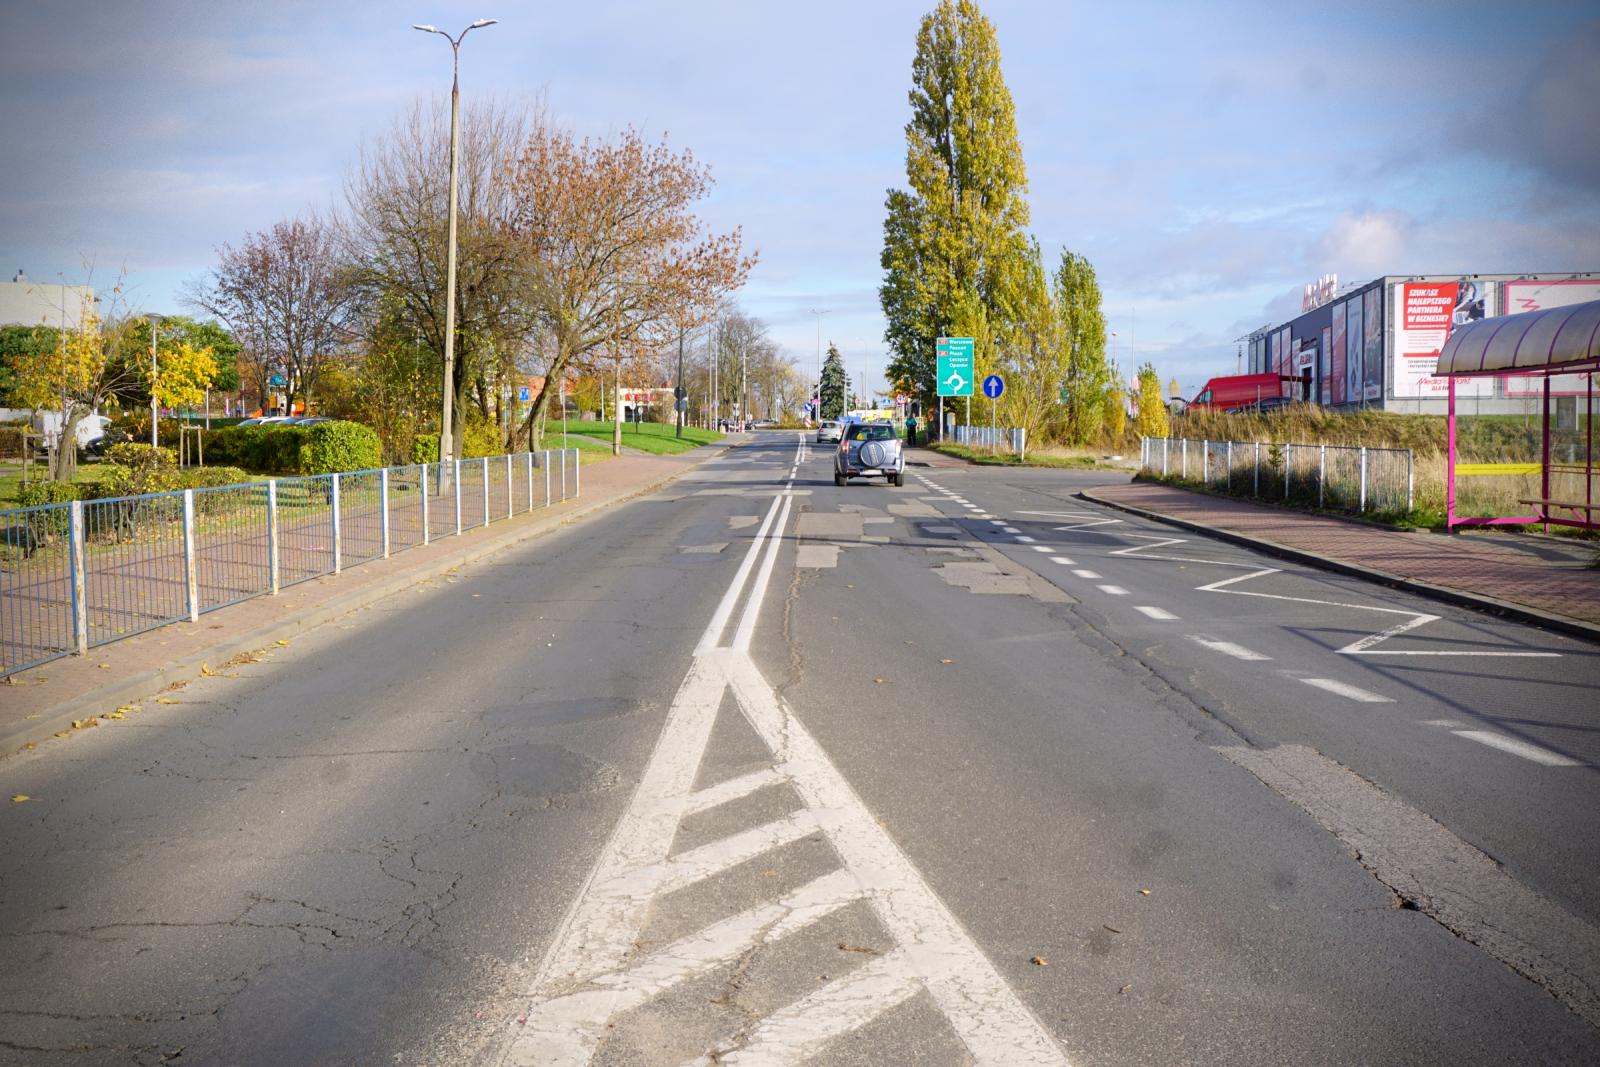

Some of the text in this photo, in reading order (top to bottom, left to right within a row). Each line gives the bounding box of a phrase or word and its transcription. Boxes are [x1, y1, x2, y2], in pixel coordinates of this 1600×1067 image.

[1409, 288, 1439, 297] SZUKASZ
[1407, 297, 1452, 305] NAJLEPSZEGO
[1407, 306, 1443, 314] PARTNERA
